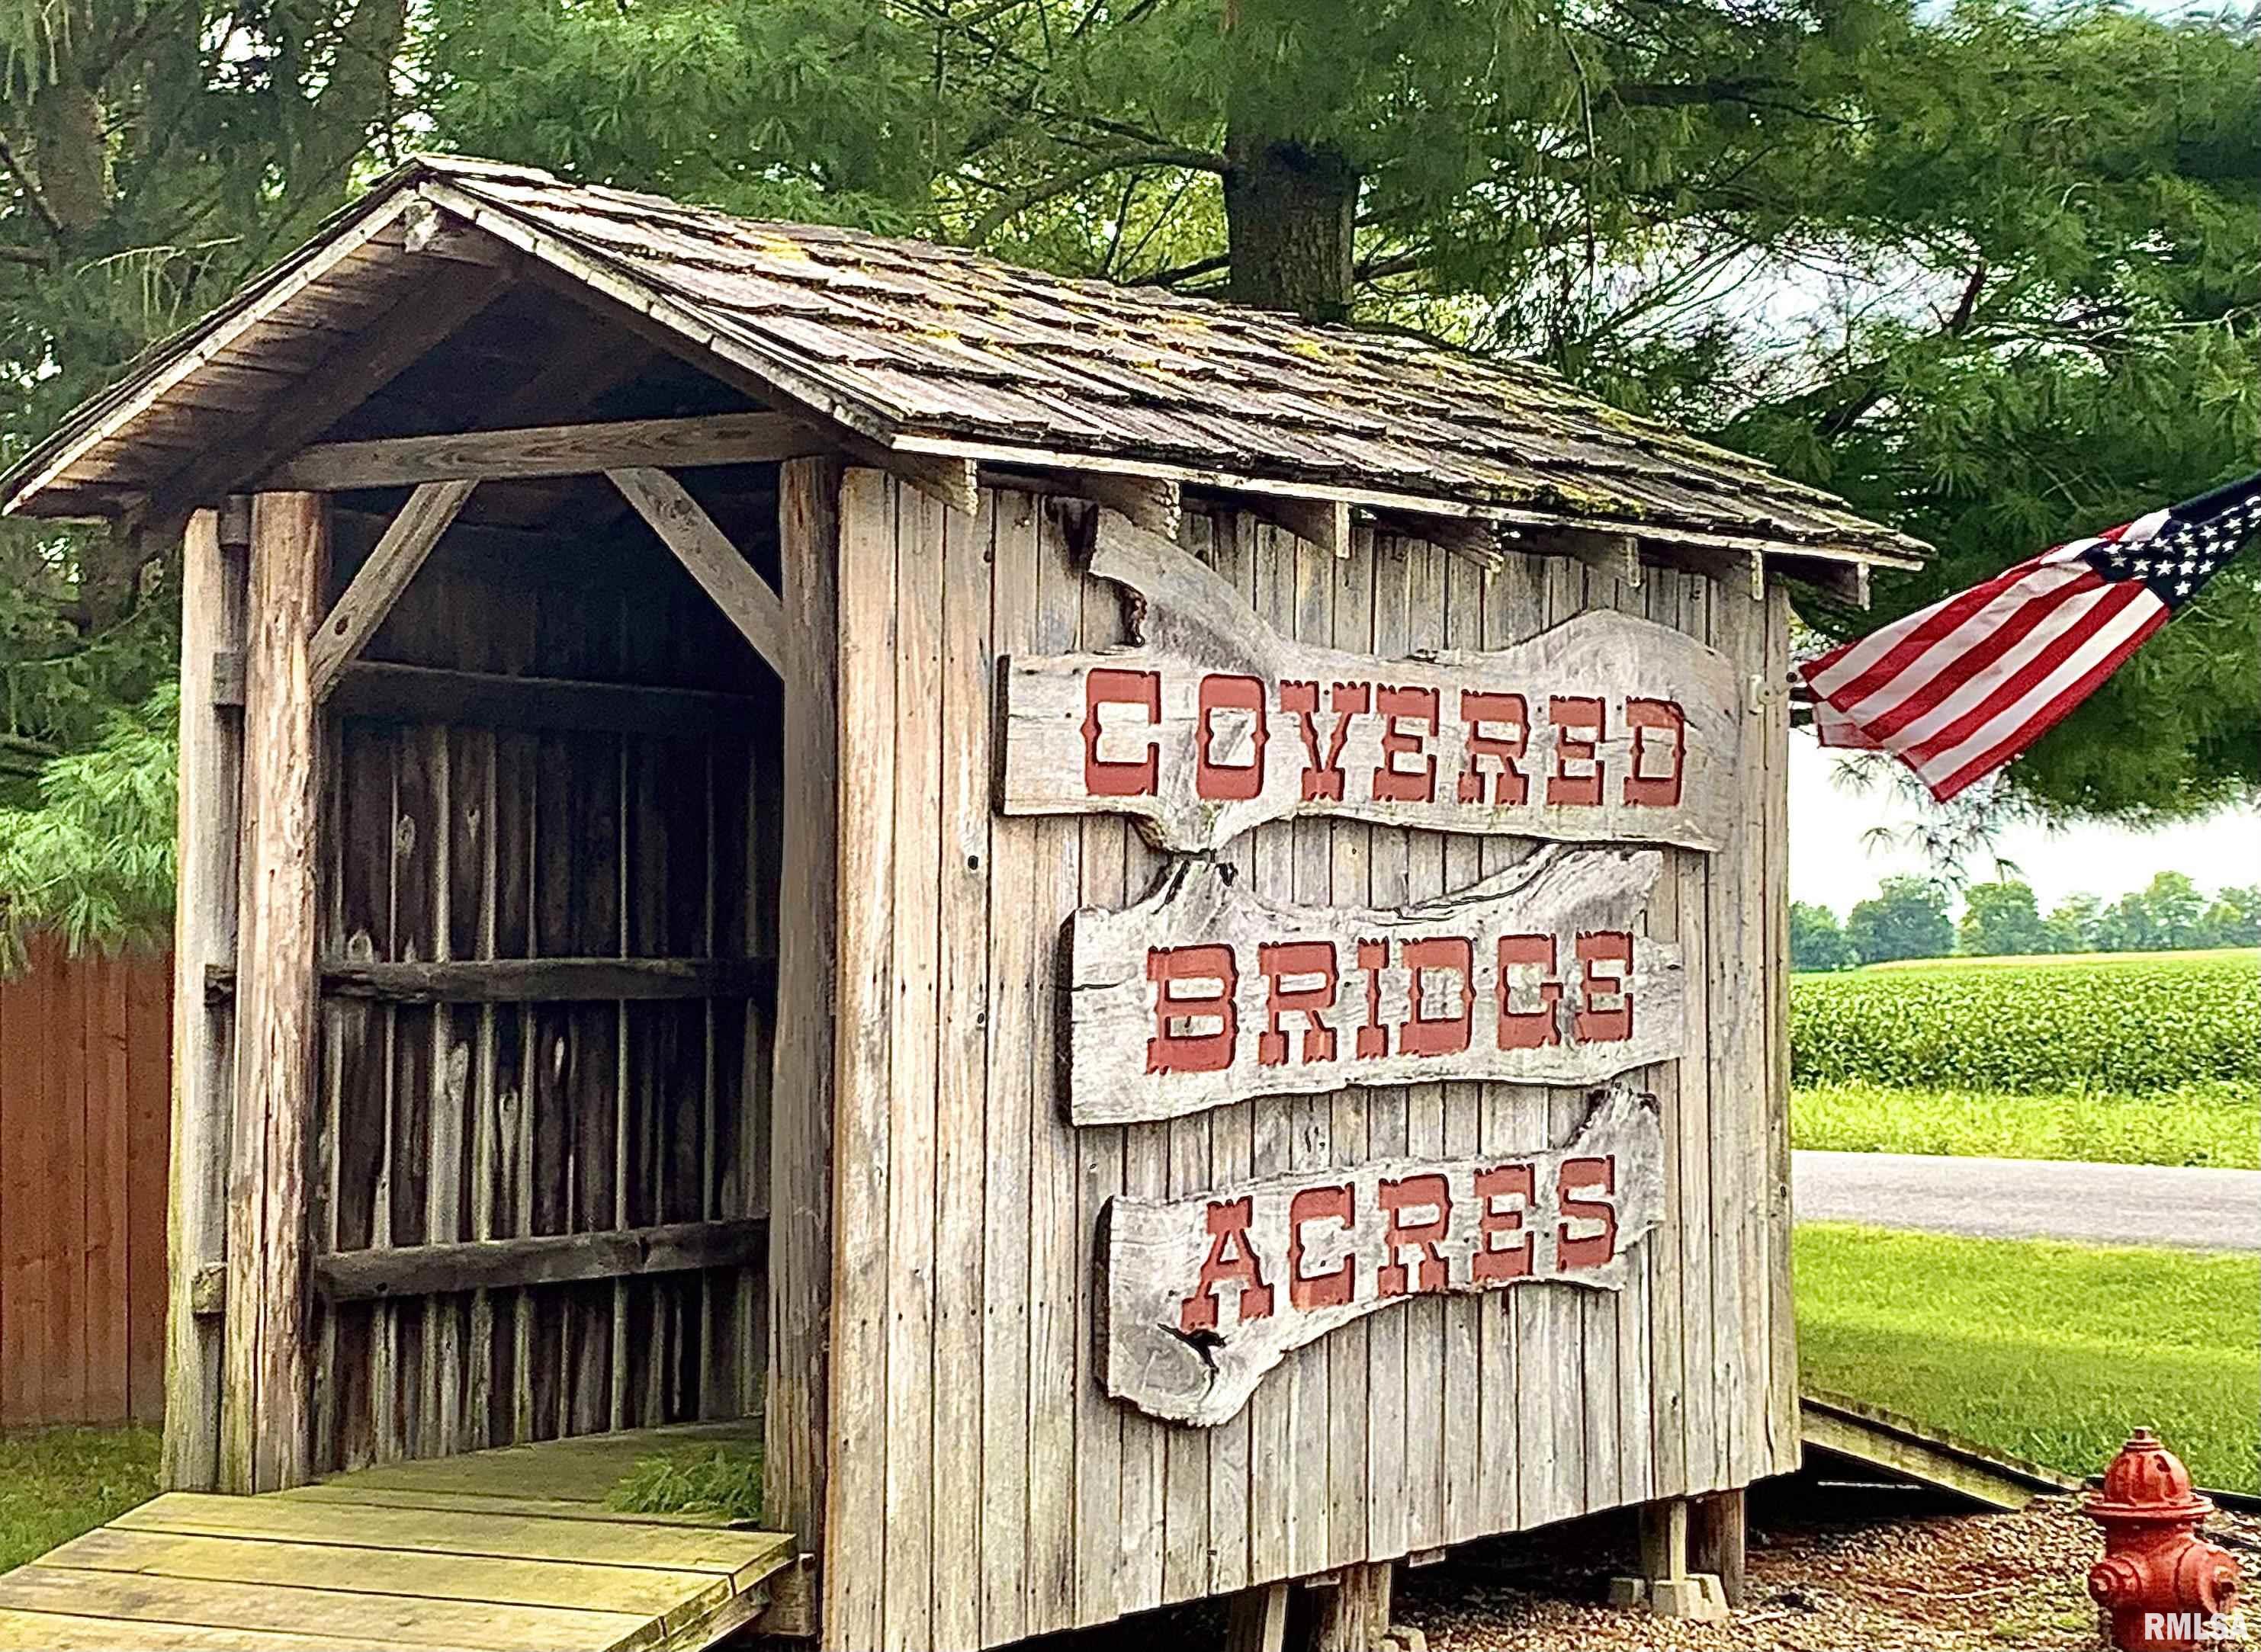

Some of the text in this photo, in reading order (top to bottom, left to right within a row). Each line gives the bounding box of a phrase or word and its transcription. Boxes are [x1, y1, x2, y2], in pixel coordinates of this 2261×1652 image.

[1081, 668, 1686, 808] COVERED
[1145, 930, 1634, 1076] BRIDGE
[1180, 1154, 1619, 1333] ACRES
